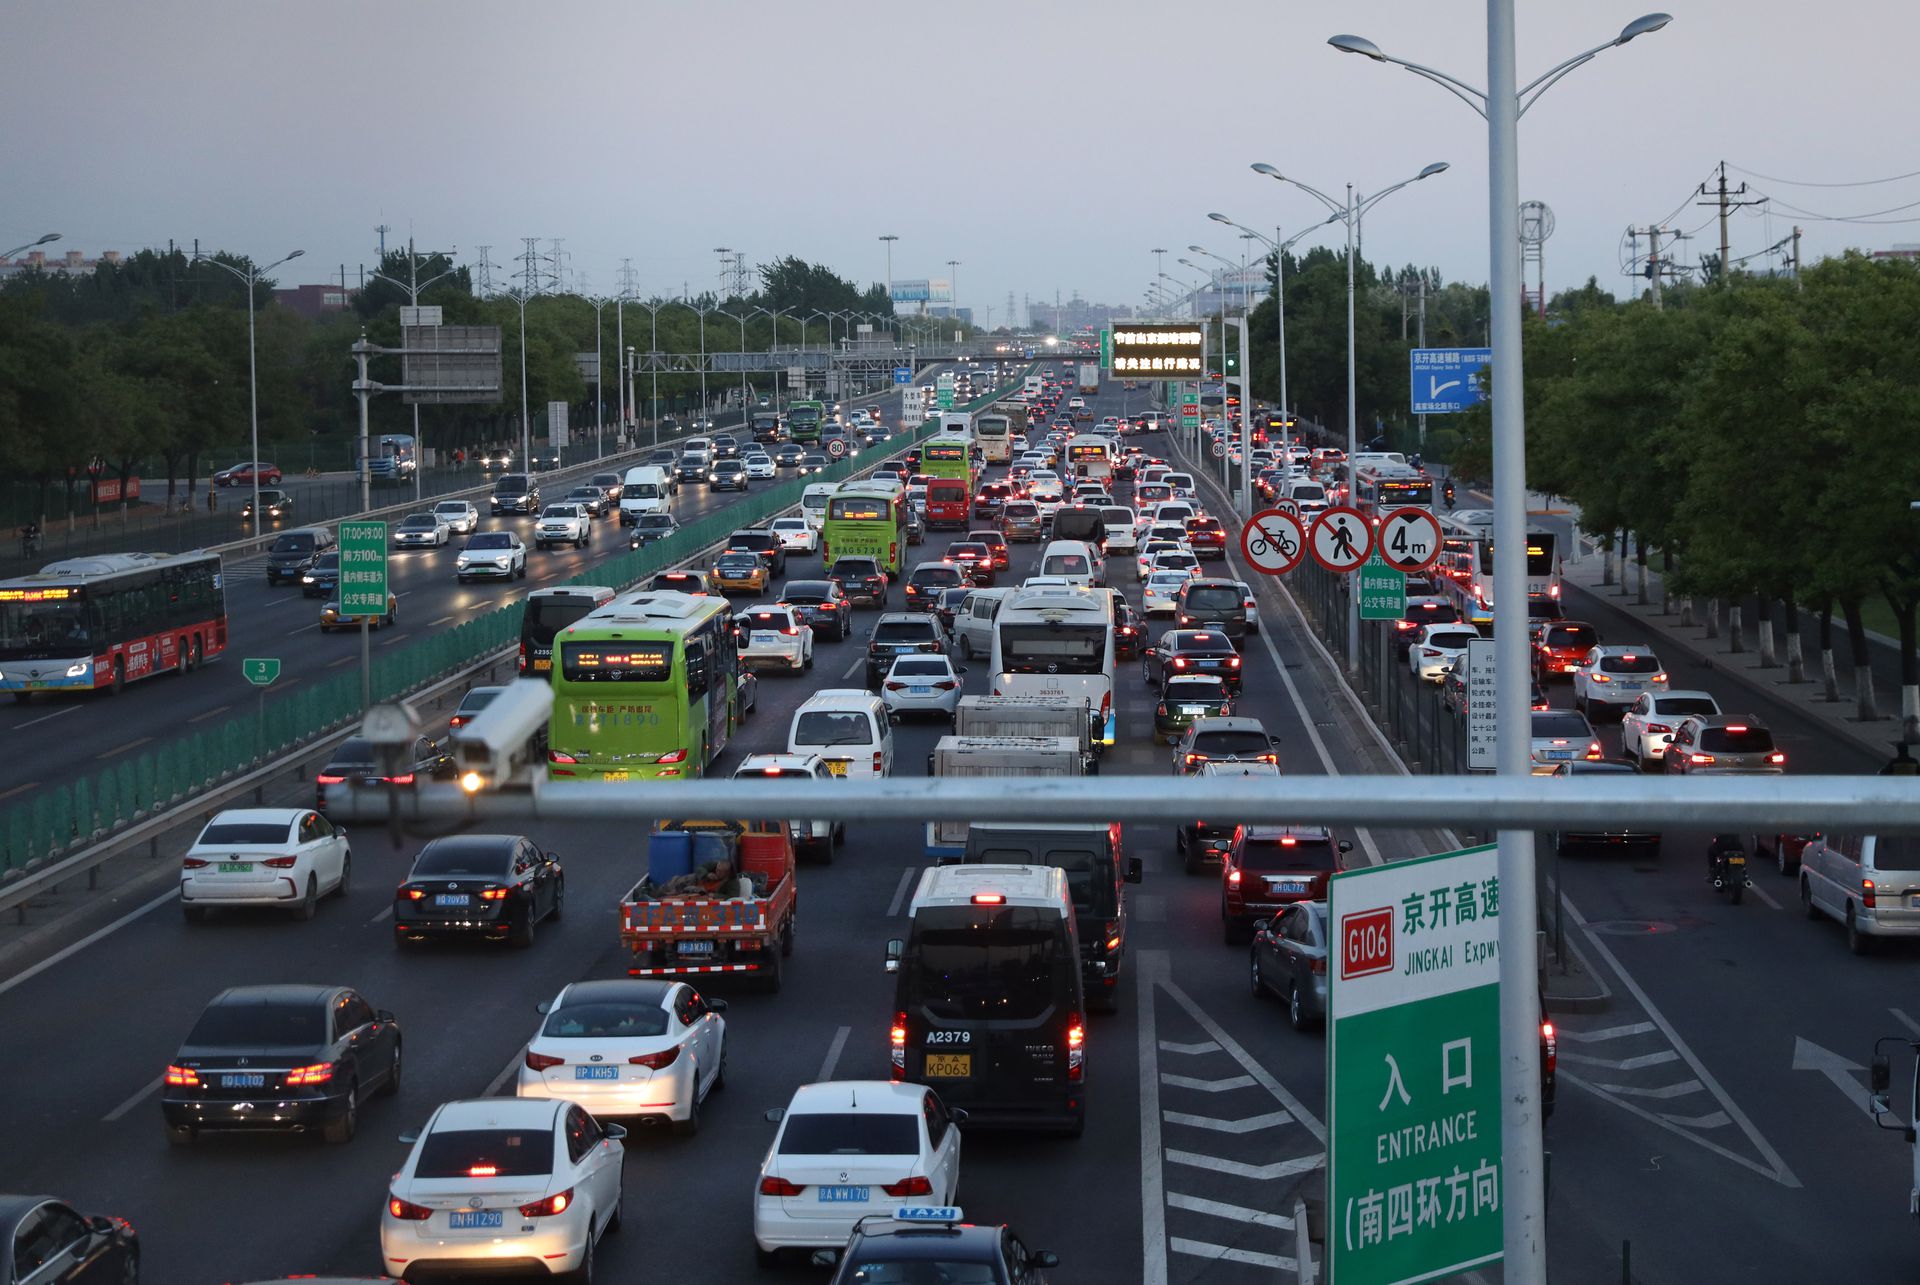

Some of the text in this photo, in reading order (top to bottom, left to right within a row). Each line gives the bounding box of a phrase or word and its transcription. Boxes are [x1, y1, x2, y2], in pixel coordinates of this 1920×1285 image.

[1114, 357, 1201, 370] 请关注出行路况
[831, 443, 842, 453] 80
[1214, 445, 1224, 455] 80
[342, 528, 383, 539] 17:00-19:00
[1391, 526, 1426, 553] 4 m
[343, 550, 383, 562] 前方100m
[343, 571, 383, 583] 最内侧车道为
[343, 593, 383, 606] 公交专用道
[1363, 597, 1401, 609] 公交专用道
[258, 662, 266, 673] 3
[1349, 923, 1387, 963] G106
[1404, 945, 1453, 976] JINGKAI
[926, 1031, 971, 1044] A2379
[928, 1063, 969, 1076] KP063
[1379, 1037, 1472, 1112] 入口
[1377, 1110, 1477, 1164] ENTRANCE
[1346, 1156, 1504, 1251] (南四环方向
[903, 1207, 951, 1216] TAXI
